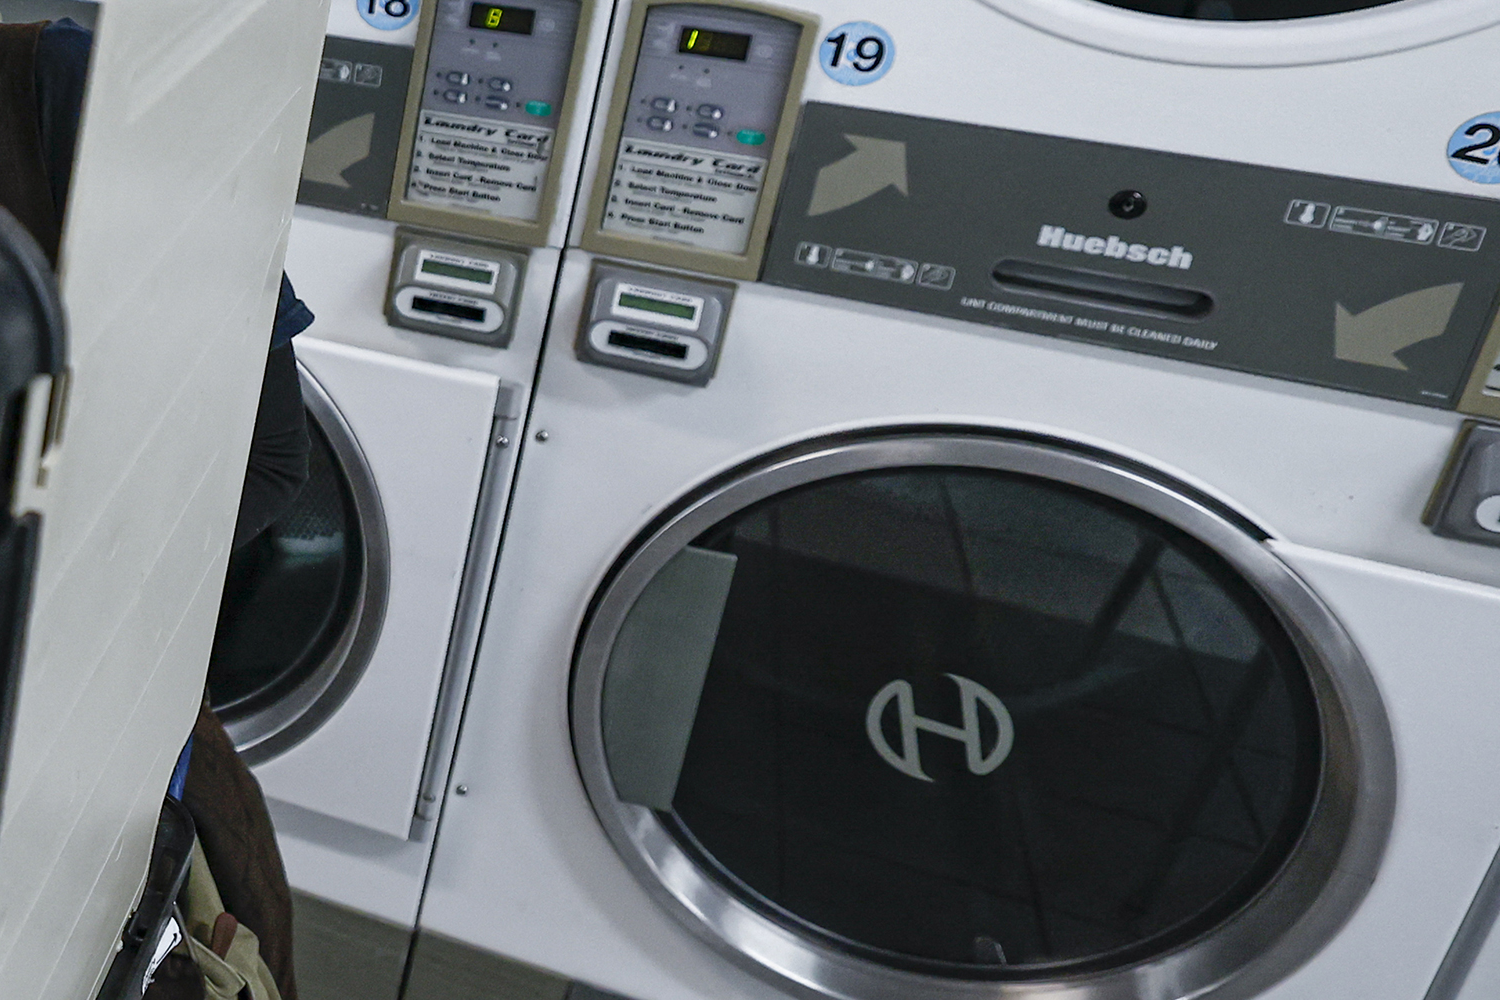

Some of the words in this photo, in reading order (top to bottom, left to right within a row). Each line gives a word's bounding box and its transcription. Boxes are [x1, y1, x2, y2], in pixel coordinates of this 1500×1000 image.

[824, 31, 883, 73] 19
[1451, 123, 1500, 168] 2
[1036, 224, 1194, 270] Huebsch
[1074, 317, 1109, 331] MUST
